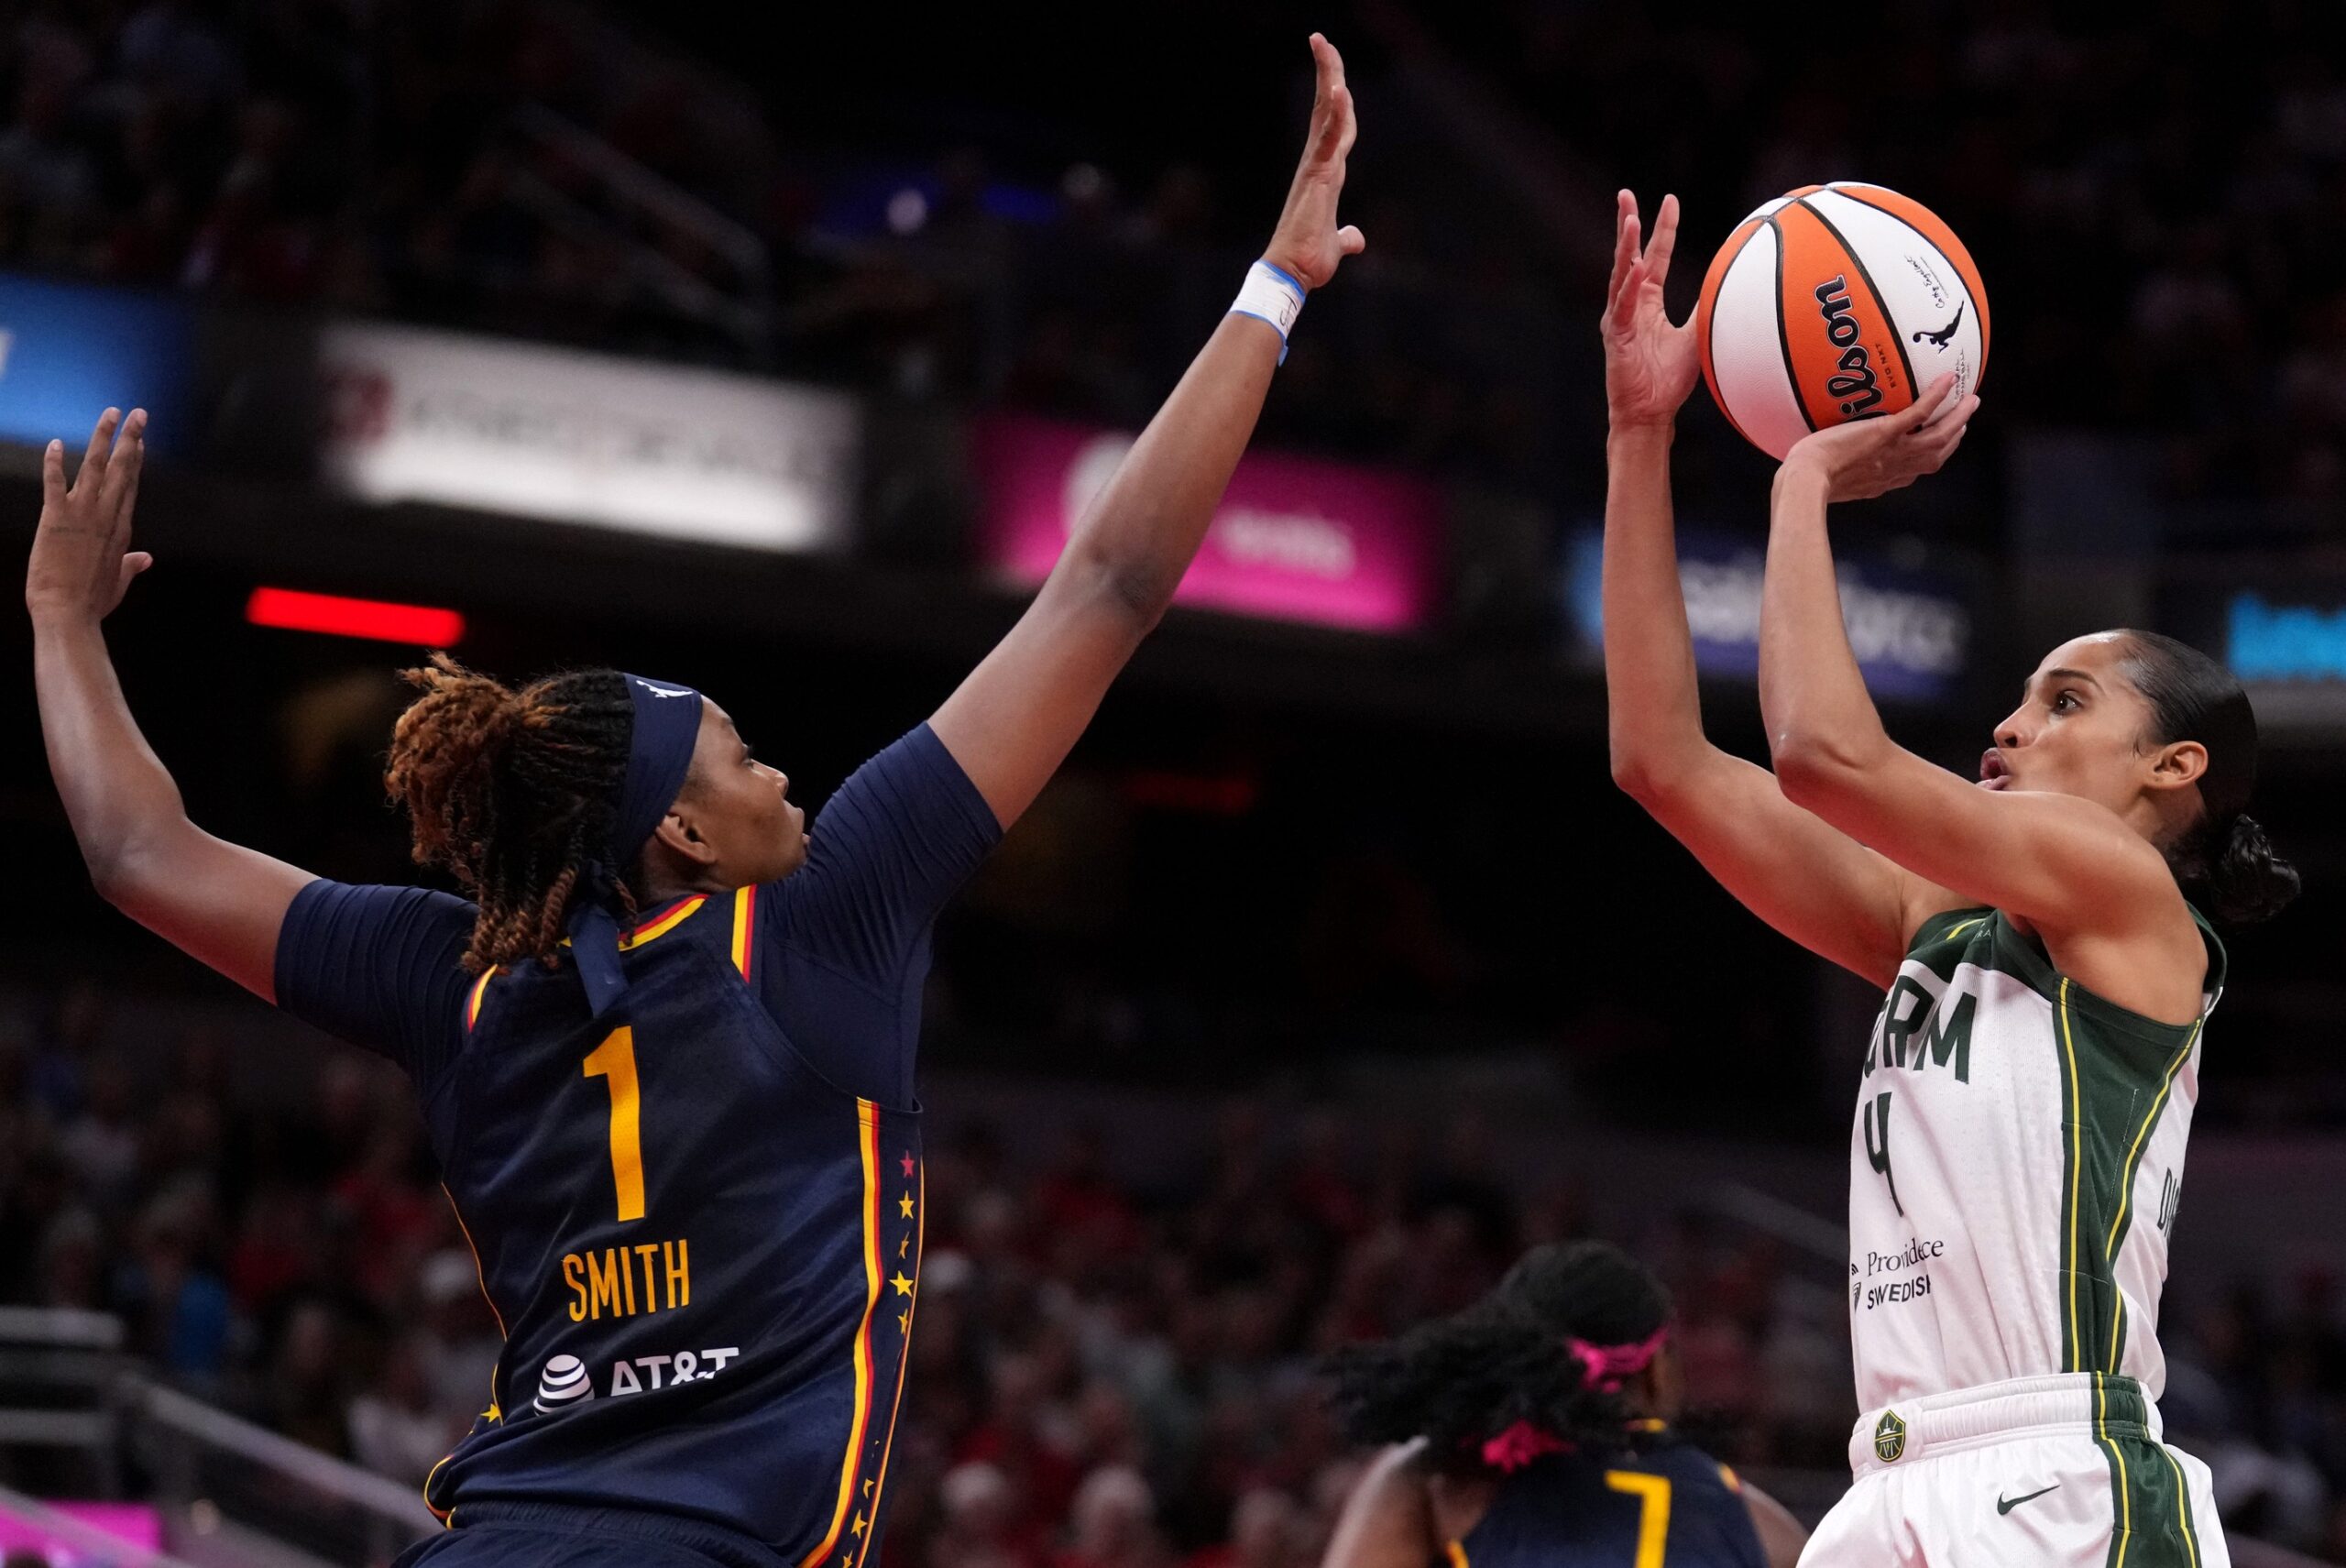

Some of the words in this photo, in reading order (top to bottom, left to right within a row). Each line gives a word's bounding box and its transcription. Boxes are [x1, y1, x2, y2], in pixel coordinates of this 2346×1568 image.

[1814, 274, 1894, 421] ilson
[1874, 343, 1888, 365] NXT
[1884, 367, 1897, 389] EVO
[1864, 974, 1978, 1085] ORM
[582, 1025, 645, 1223] 1
[1864, 1091, 1904, 1217] 4
[562, 1238, 691, 1322] SMITH
[609, 1346, 740, 1398] AT&T
[1605, 1469, 1672, 1568] 7
